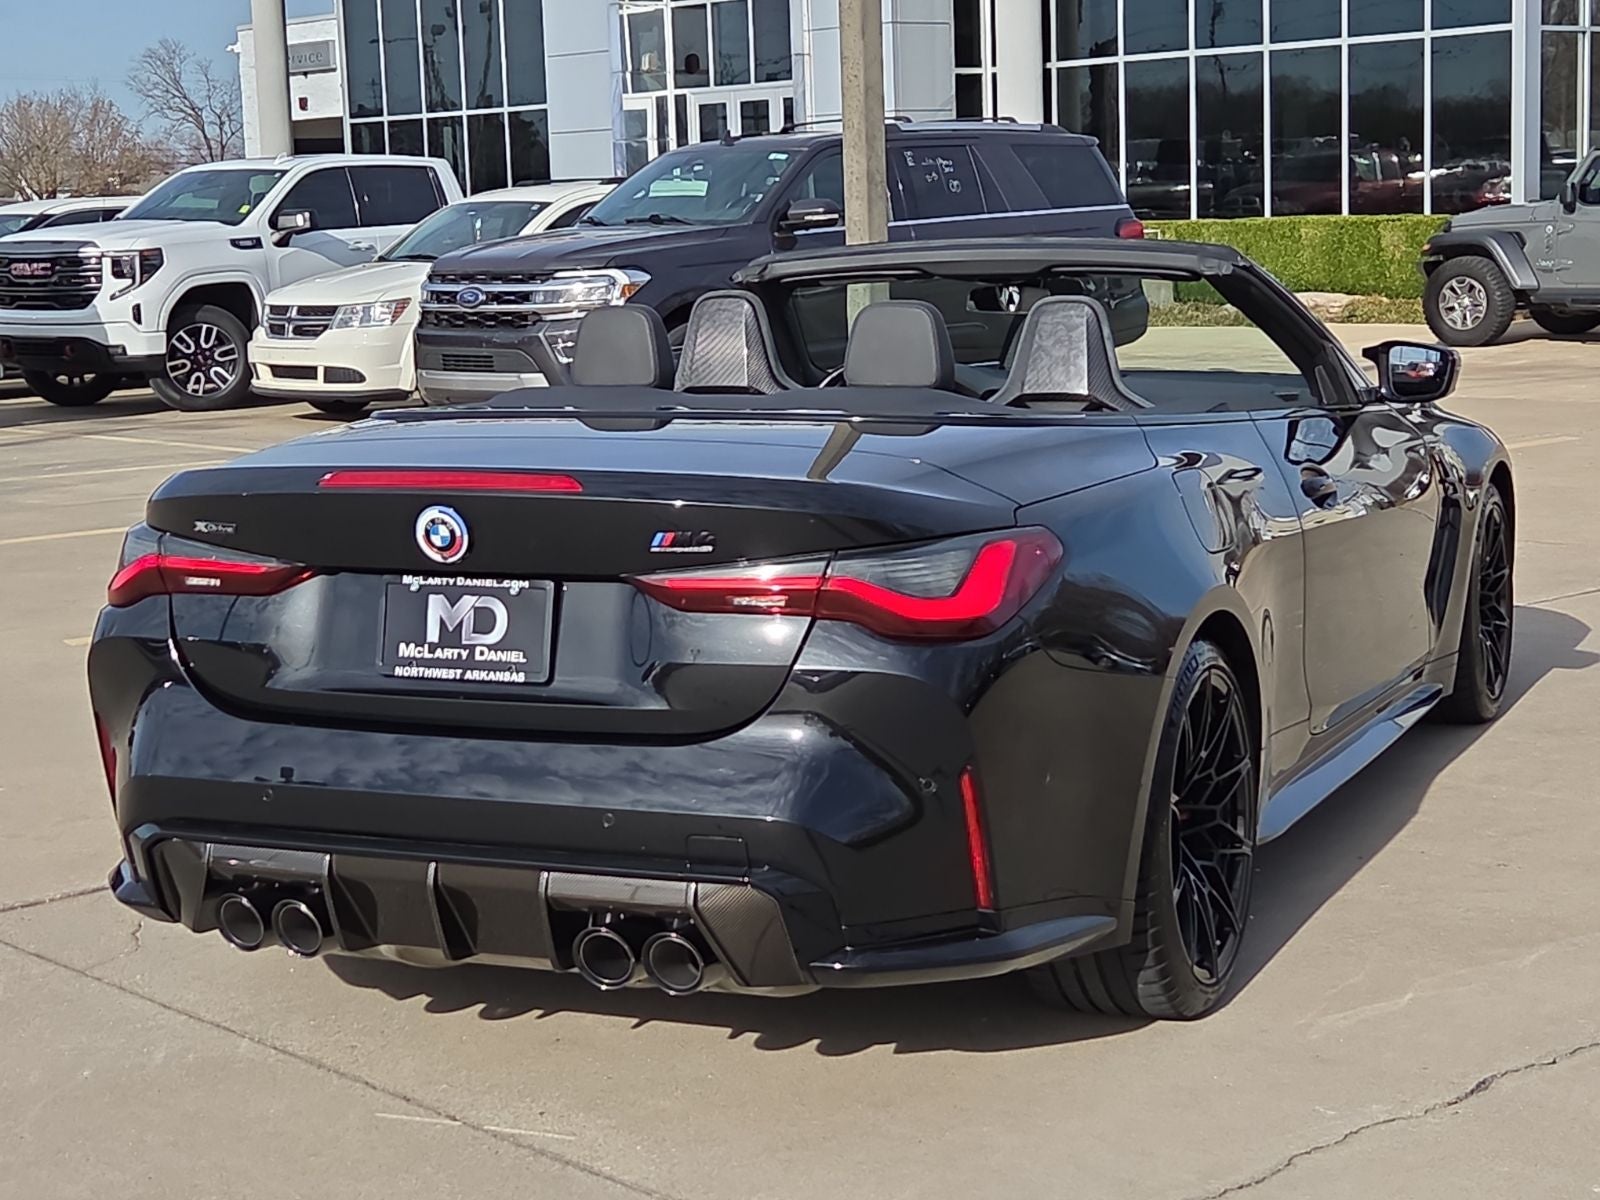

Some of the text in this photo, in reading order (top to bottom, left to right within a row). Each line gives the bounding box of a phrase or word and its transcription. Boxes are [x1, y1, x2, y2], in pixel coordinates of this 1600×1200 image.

[288, 52, 323, 64] rvice
[10, 262, 52, 276] GMC
[426, 593, 509, 645] MD
[474, 645, 527, 663] DANIEL
[394, 665, 526, 683] NORTHWEST ARKANSAS
